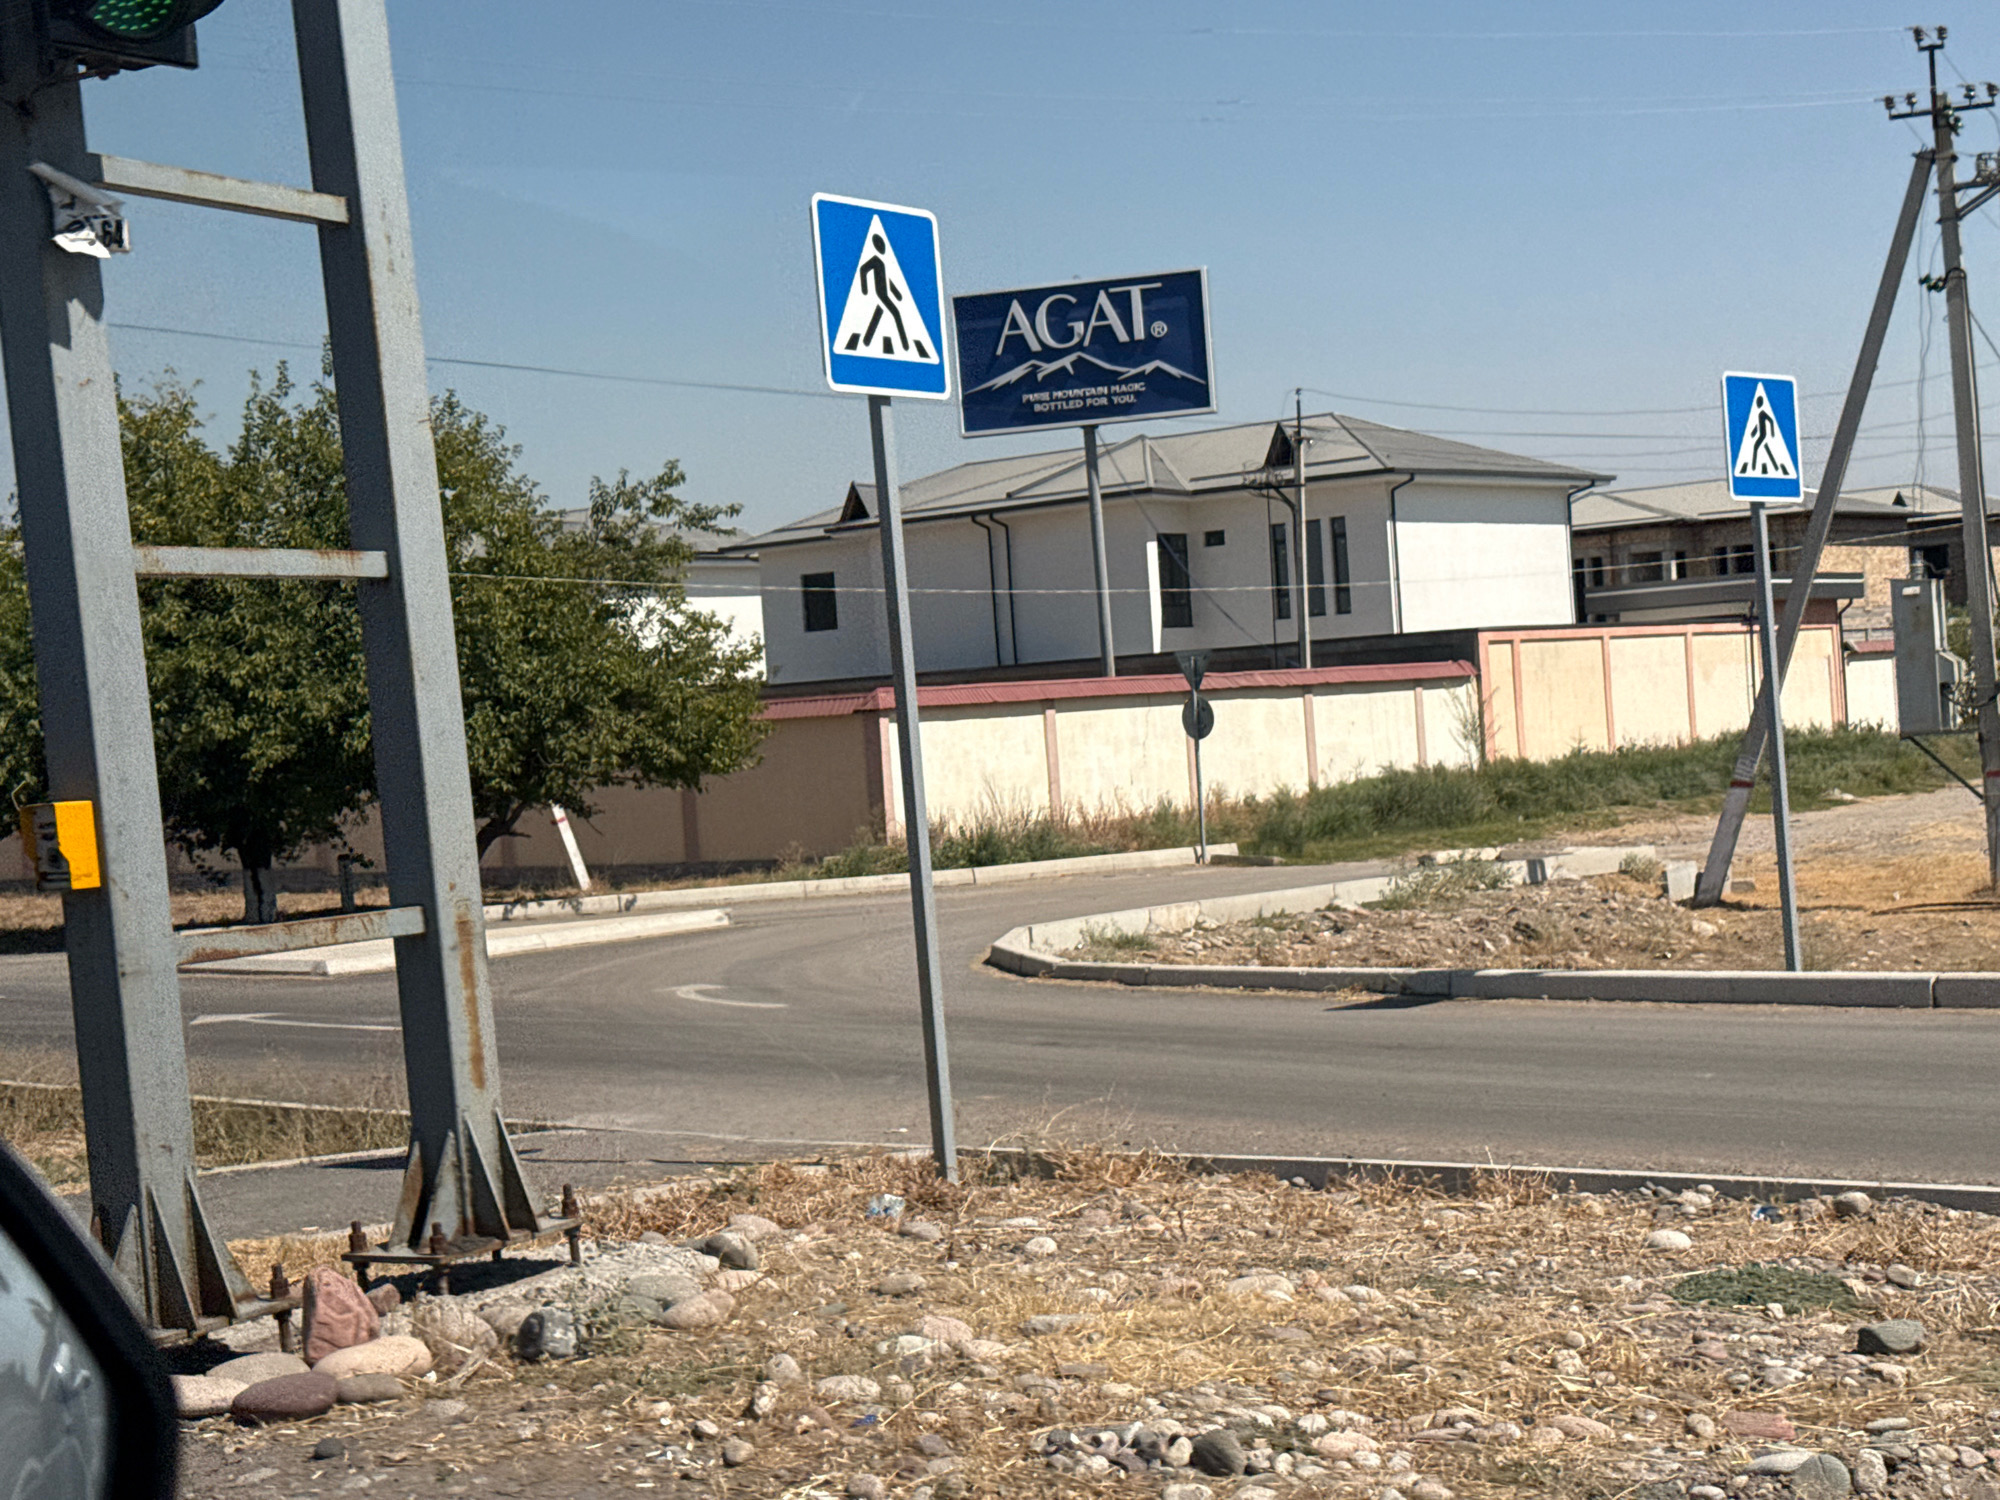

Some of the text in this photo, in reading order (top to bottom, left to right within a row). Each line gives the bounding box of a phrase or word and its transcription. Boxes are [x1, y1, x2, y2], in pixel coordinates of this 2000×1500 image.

[1022, 382, 1146, 403] PURE MOUNTAIN MAGIC
[1033, 394, 1137, 412] BOTTLED FOR YOU.
